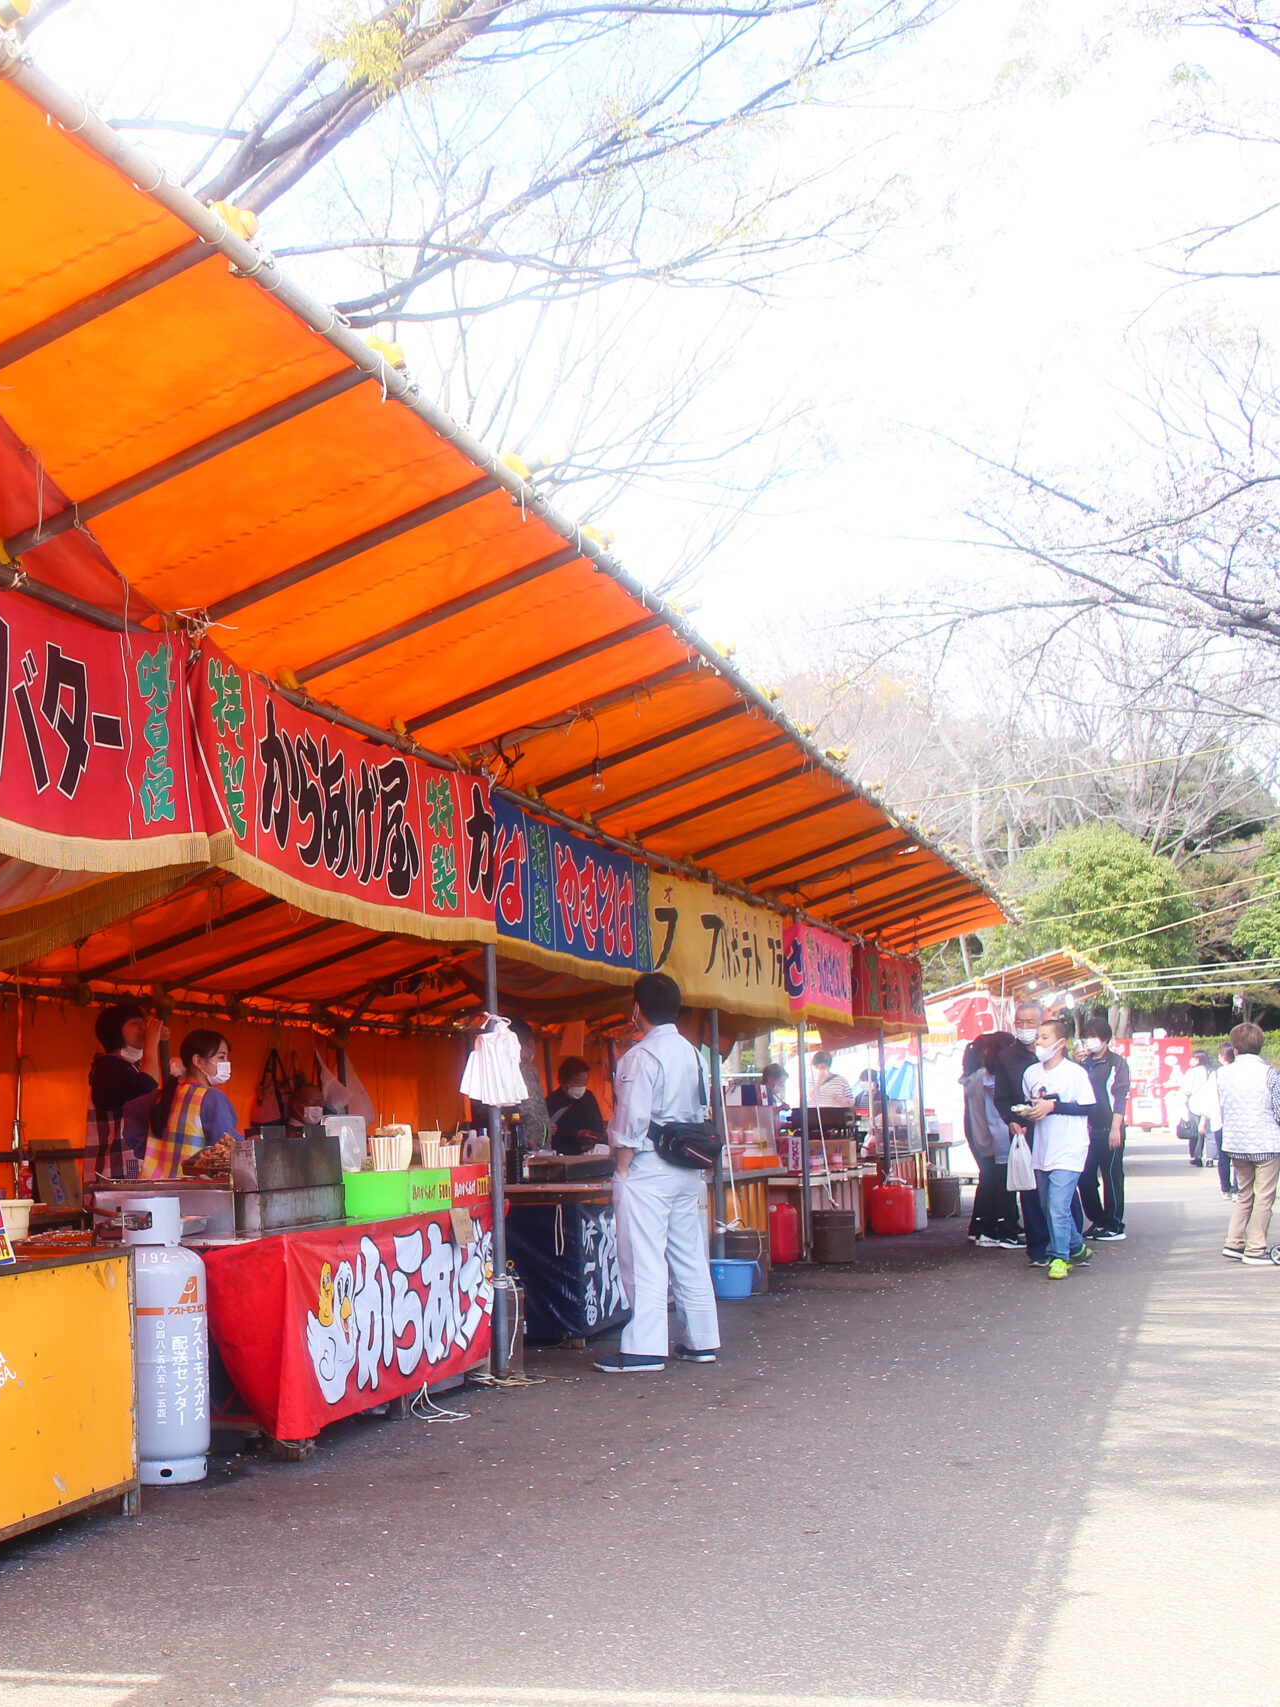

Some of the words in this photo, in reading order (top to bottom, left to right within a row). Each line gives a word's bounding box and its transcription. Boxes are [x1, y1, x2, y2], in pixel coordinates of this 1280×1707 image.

[136, 642, 177, 826] 味自慢
[259, 695, 420, 899] からあげ屋
[425, 773, 458, 910] 特製
[529, 824, 552, 944] 特製
[553, 841, 635, 958] やきそば
[354, 1218, 484, 1392] からあげ
[582, 1217, 598, 1327] 味一番
[171, 1335, 189, 1427] 配送センター
[191, 1316, 206, 1422] アストモスガス
